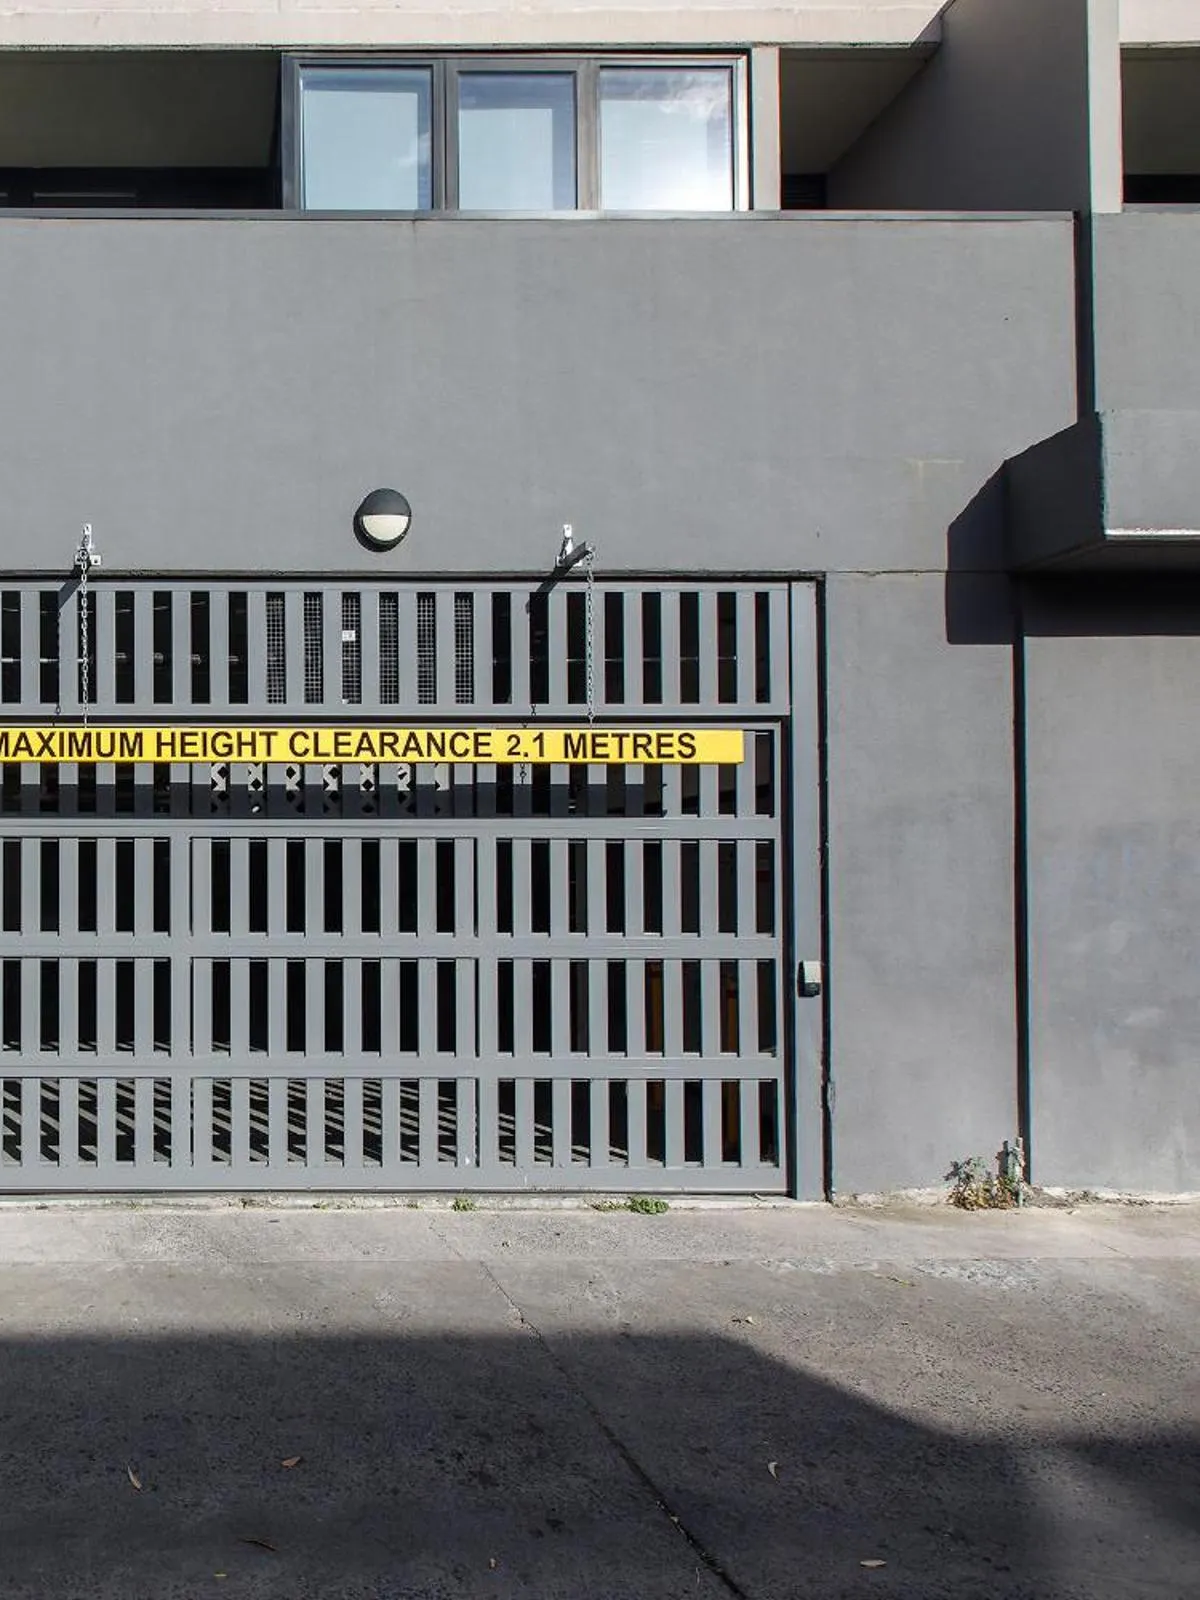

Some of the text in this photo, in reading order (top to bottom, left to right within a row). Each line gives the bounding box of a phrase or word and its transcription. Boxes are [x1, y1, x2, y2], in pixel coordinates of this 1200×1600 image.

[156, 730, 278, 758] HEIGHT
[289, 730, 493, 758] CLEARANCE
[506, 733, 546, 758] 2.1
[564, 732, 698, 759] METRES
